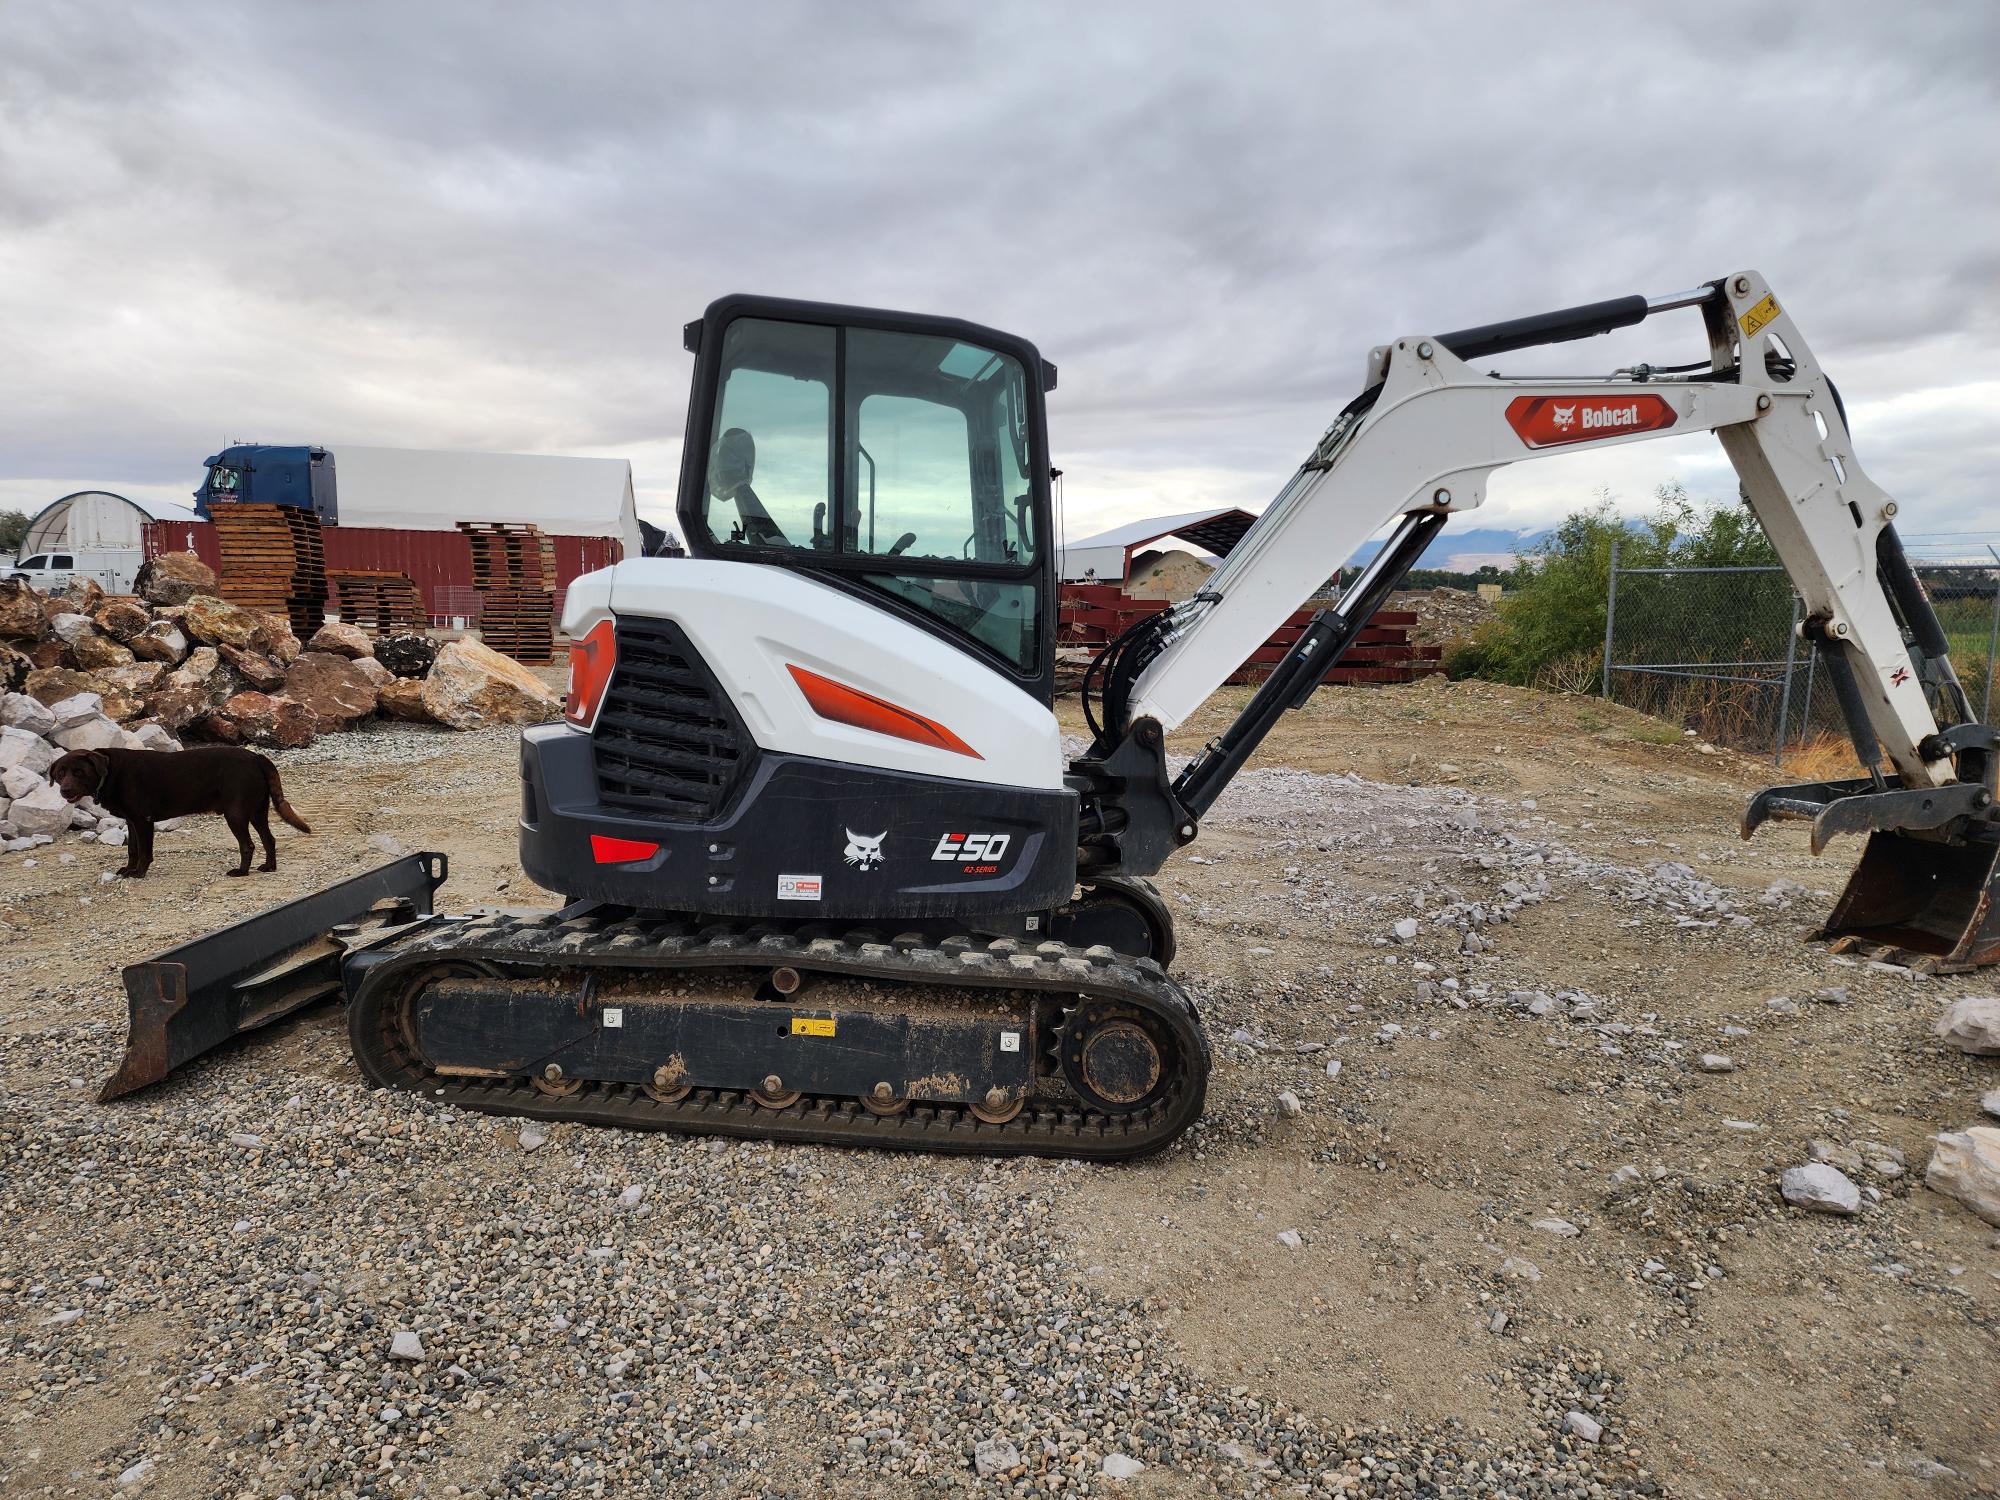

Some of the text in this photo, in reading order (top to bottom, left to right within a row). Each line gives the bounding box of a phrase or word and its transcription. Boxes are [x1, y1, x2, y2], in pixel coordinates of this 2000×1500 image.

[1581, 404, 1638, 429] Bobcat
[931, 833, 1011, 861] E50
[964, 865, 998, 873] R2-SERIES
